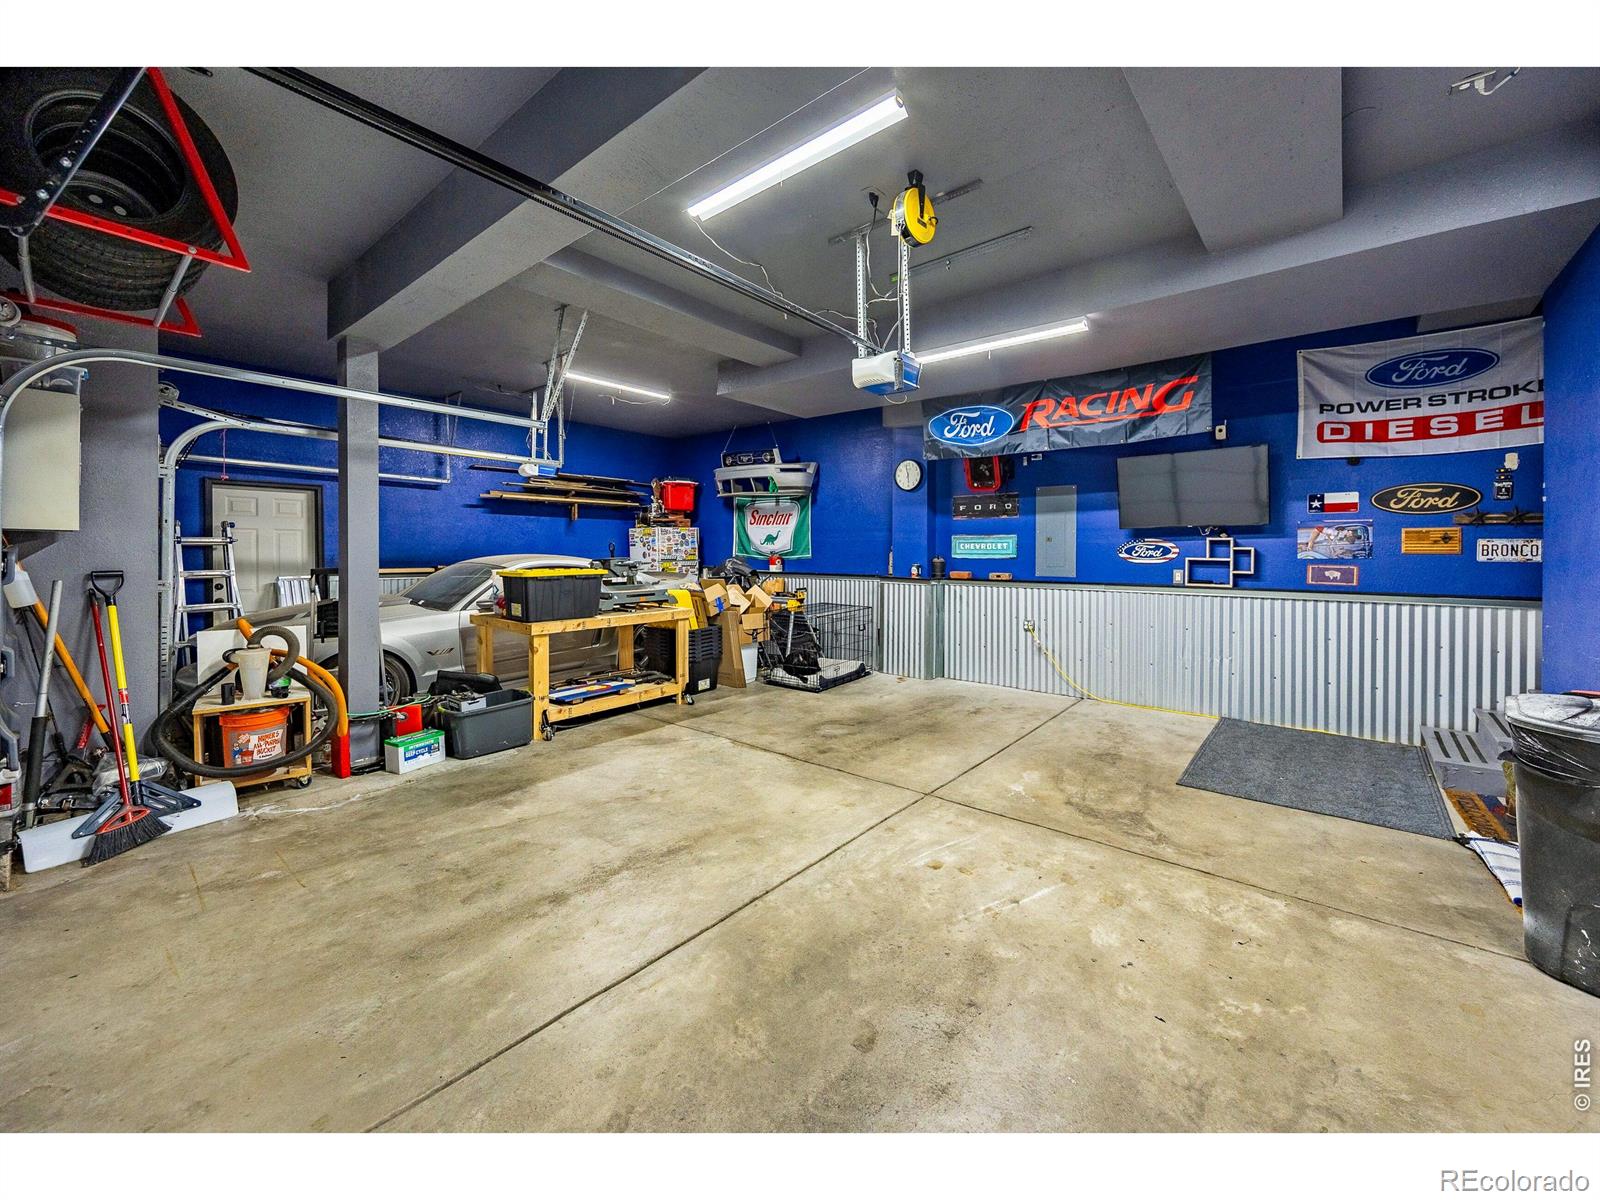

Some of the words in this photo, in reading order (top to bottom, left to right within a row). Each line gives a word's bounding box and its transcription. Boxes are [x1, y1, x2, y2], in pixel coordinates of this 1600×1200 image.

[1391, 355, 1468, 383] Ford
[943, 411, 996, 438] Ford
[1019, 375, 1199, 432] RACING
[1319, 397, 1422, 415] POWER
[1323, 405, 1544, 440] DIESEL
[1389, 487, 1461, 509] Ford
[959, 503, 1012, 511] FORD
[749, 509, 793, 526] Sinclair
[959, 542, 1009, 550] CHEVROLET
[1131, 544, 1164, 557] Ford
[1481, 543, 1539, 557] BRONCO
